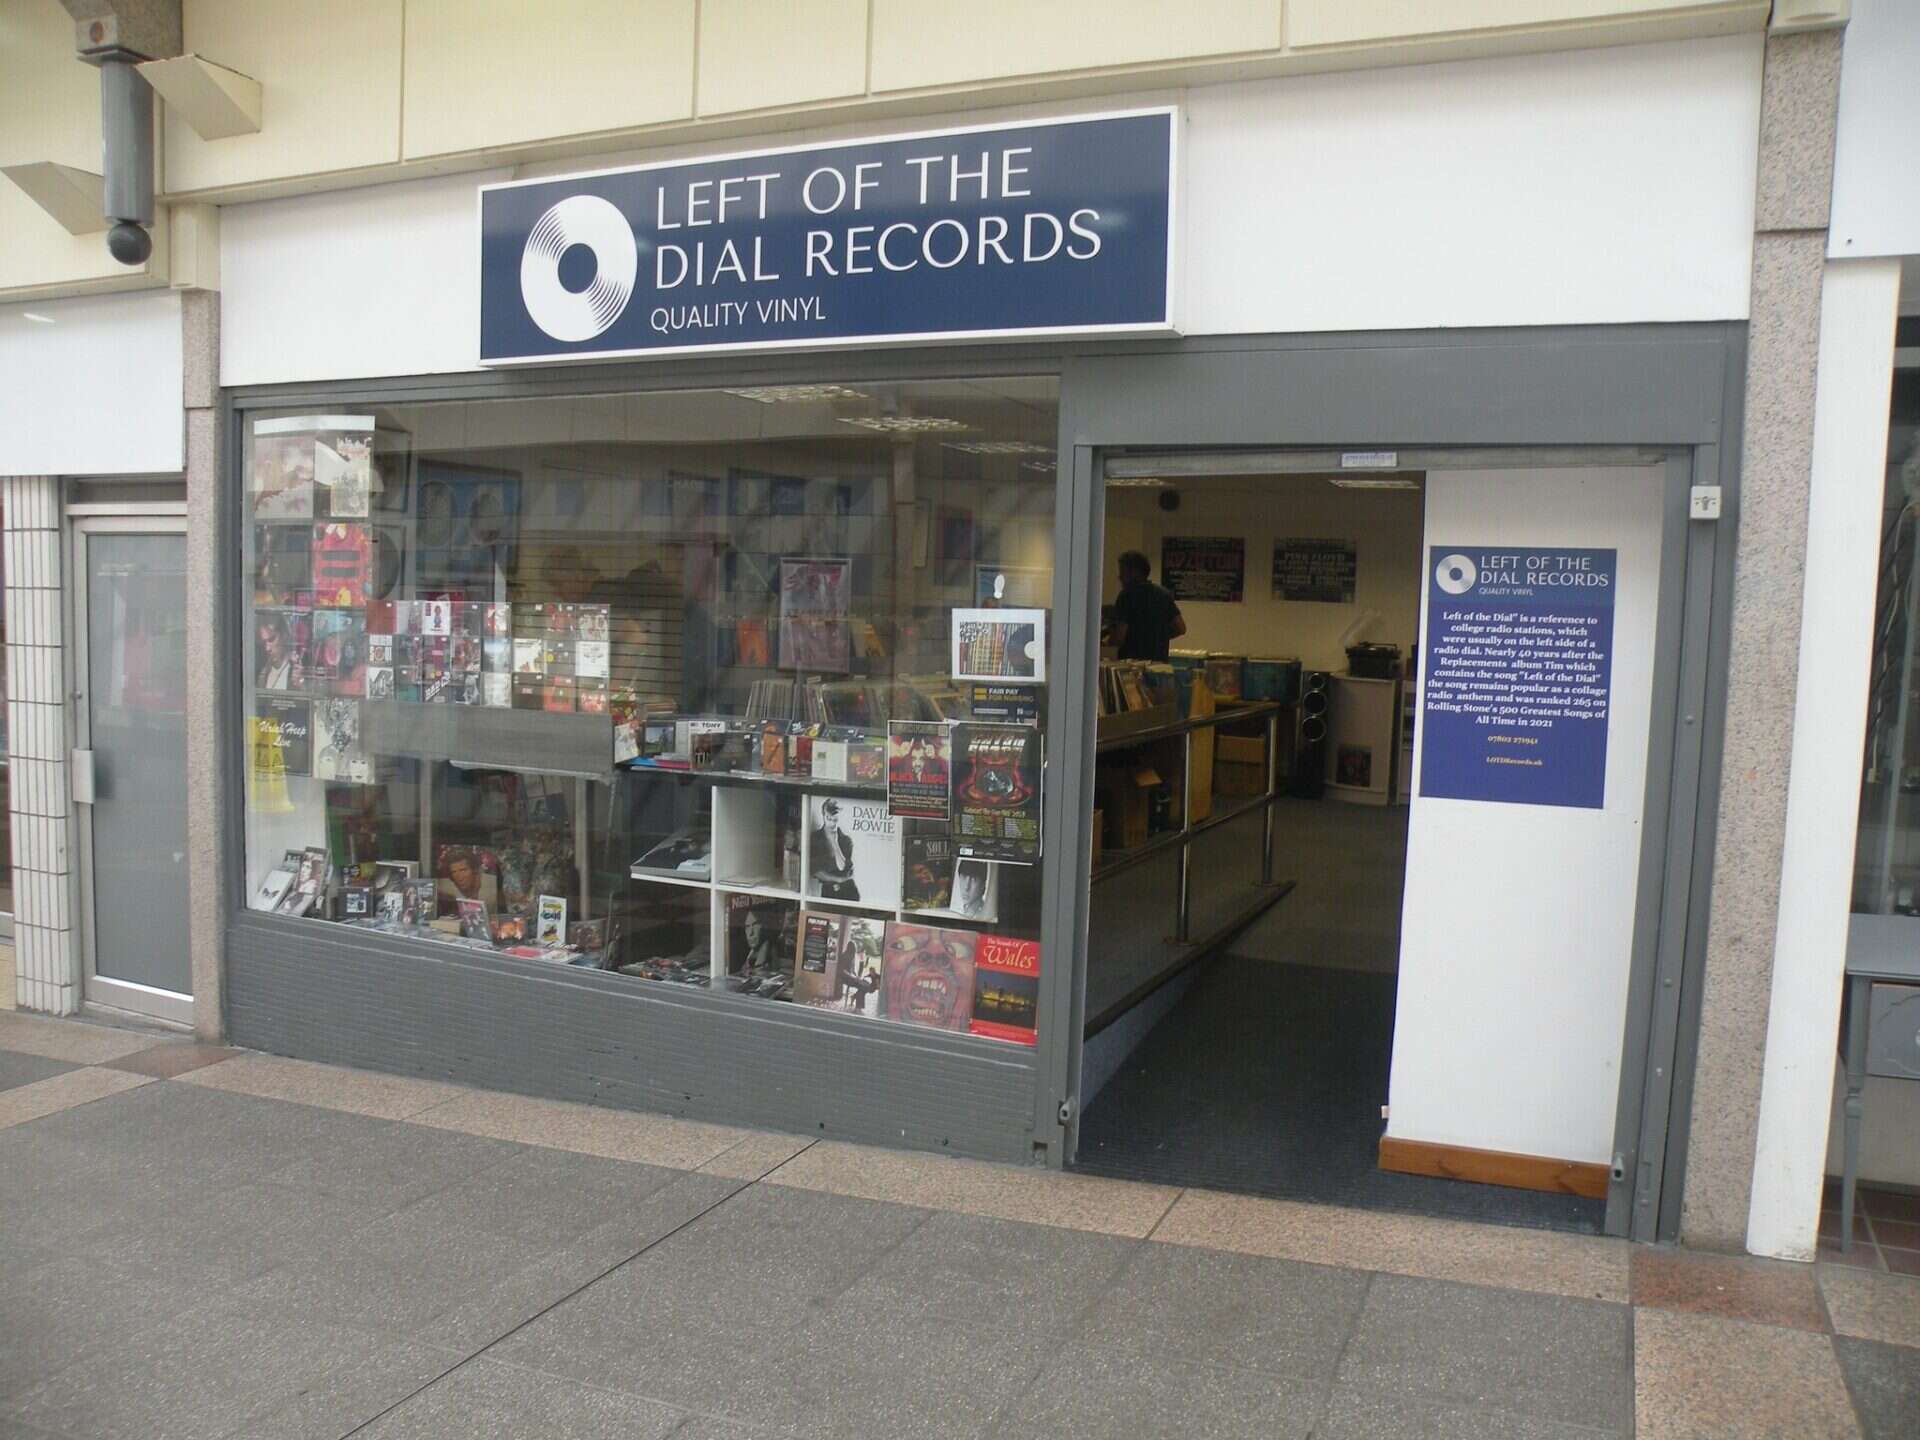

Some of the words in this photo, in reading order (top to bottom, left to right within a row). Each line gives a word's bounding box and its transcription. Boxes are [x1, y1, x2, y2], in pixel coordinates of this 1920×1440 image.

[656, 173, 781, 231] LEFT
[802, 162, 882, 215] OF
[905, 147, 1032, 203] THE
[655, 236, 779, 290] DIAL
[805, 208, 1102, 277] RECORDS
[650, 301, 748, 333] QUALITY
[756, 296, 826, 326] VINYL
[1481, 555, 1520, 569] LEFT
[1527, 556, 1550, 569] OF
[1556, 557, 1592, 571] THE
[1481, 571, 1520, 585] DIAL
[1527, 572, 1608, 587] RECORDS
[1479, 587, 1511, 595] QUALITY
[1513, 588, 1534, 596] VINYL
[1443, 612, 1462, 620] Left
[1464, 612, 1475, 621] of
[1476, 612, 1491, 621] the
[1520, 614, 1528, 622] is
[1538, 614, 1585, 624] reference
[1588, 616, 1598, 625] to
[1451, 624, 1484, 634] college
[1486, 625, 1512, 633] radio
[1514, 626, 1556, 636] stations,
[1557, 627, 1588, 636] which
[1468, 635, 1502, 646] usually
[1519, 637, 1534, 646] the
[1536, 637, 1553, 647] left
[1555, 638, 1575, 648] side
[1577, 639, 1589, 648] of
[1434, 646, 1459, 655] radio
[1461, 647, 1483, 656] dial.
[1484, 647, 1516, 658] Nearly
[1518, 650, 1532, 659] 40
[1533, 651, 1560, 659] years
[1561, 651, 1586, 660] after
[1588, 651, 1604, 660] the
[1440, 657, 1507, 668] Replacements
[1511, 659, 1542, 669] album
[1544, 661, 1564, 670] Tim
[1566, 662, 1596, 671] which
[1434, 669, 1475, 677] contains
[1477, 670, 1493, 679] the
[1494, 673, 1517, 681] song
[1519, 671, 1543, 681] "Left
[1545, 672, 1556, 681] of
[1557, 672, 1573, 682] the
[1575, 673, 1600, 683] Dial"
[1428, 679, 1444, 688] the
[1445, 681, 1468, 690] song
[1470, 681, 1509, 691] remains
[1510, 683, 1549, 693] popular
[1427, 691, 1452, 699] radio
[1456, 692, 1493, 702] anthem
[1495, 693, 1514, 702] and
[1536, 695, 1571, 705] ranked
[1593, 699, 1606, 707] on
[1427, 702, 1461, 713] Rolling
[1463, 703, 1497, 713] Stone's
[1499, 706, 1518, 715] 500
[1520, 706, 1561, 716] Greatest
[1563, 707, 1593, 719] Songs
[1594, 709, 1605, 718] of
[285, 722, 307, 737] Heep
[1476, 716, 1489, 724] All
[1491, 716, 1516, 726] Time
[1518, 717, 1528, 726] in
[1529, 719, 1553, 728] 2021
[852, 819, 896, 834] BOWIE
[983, 942, 1036, 969] Wales
